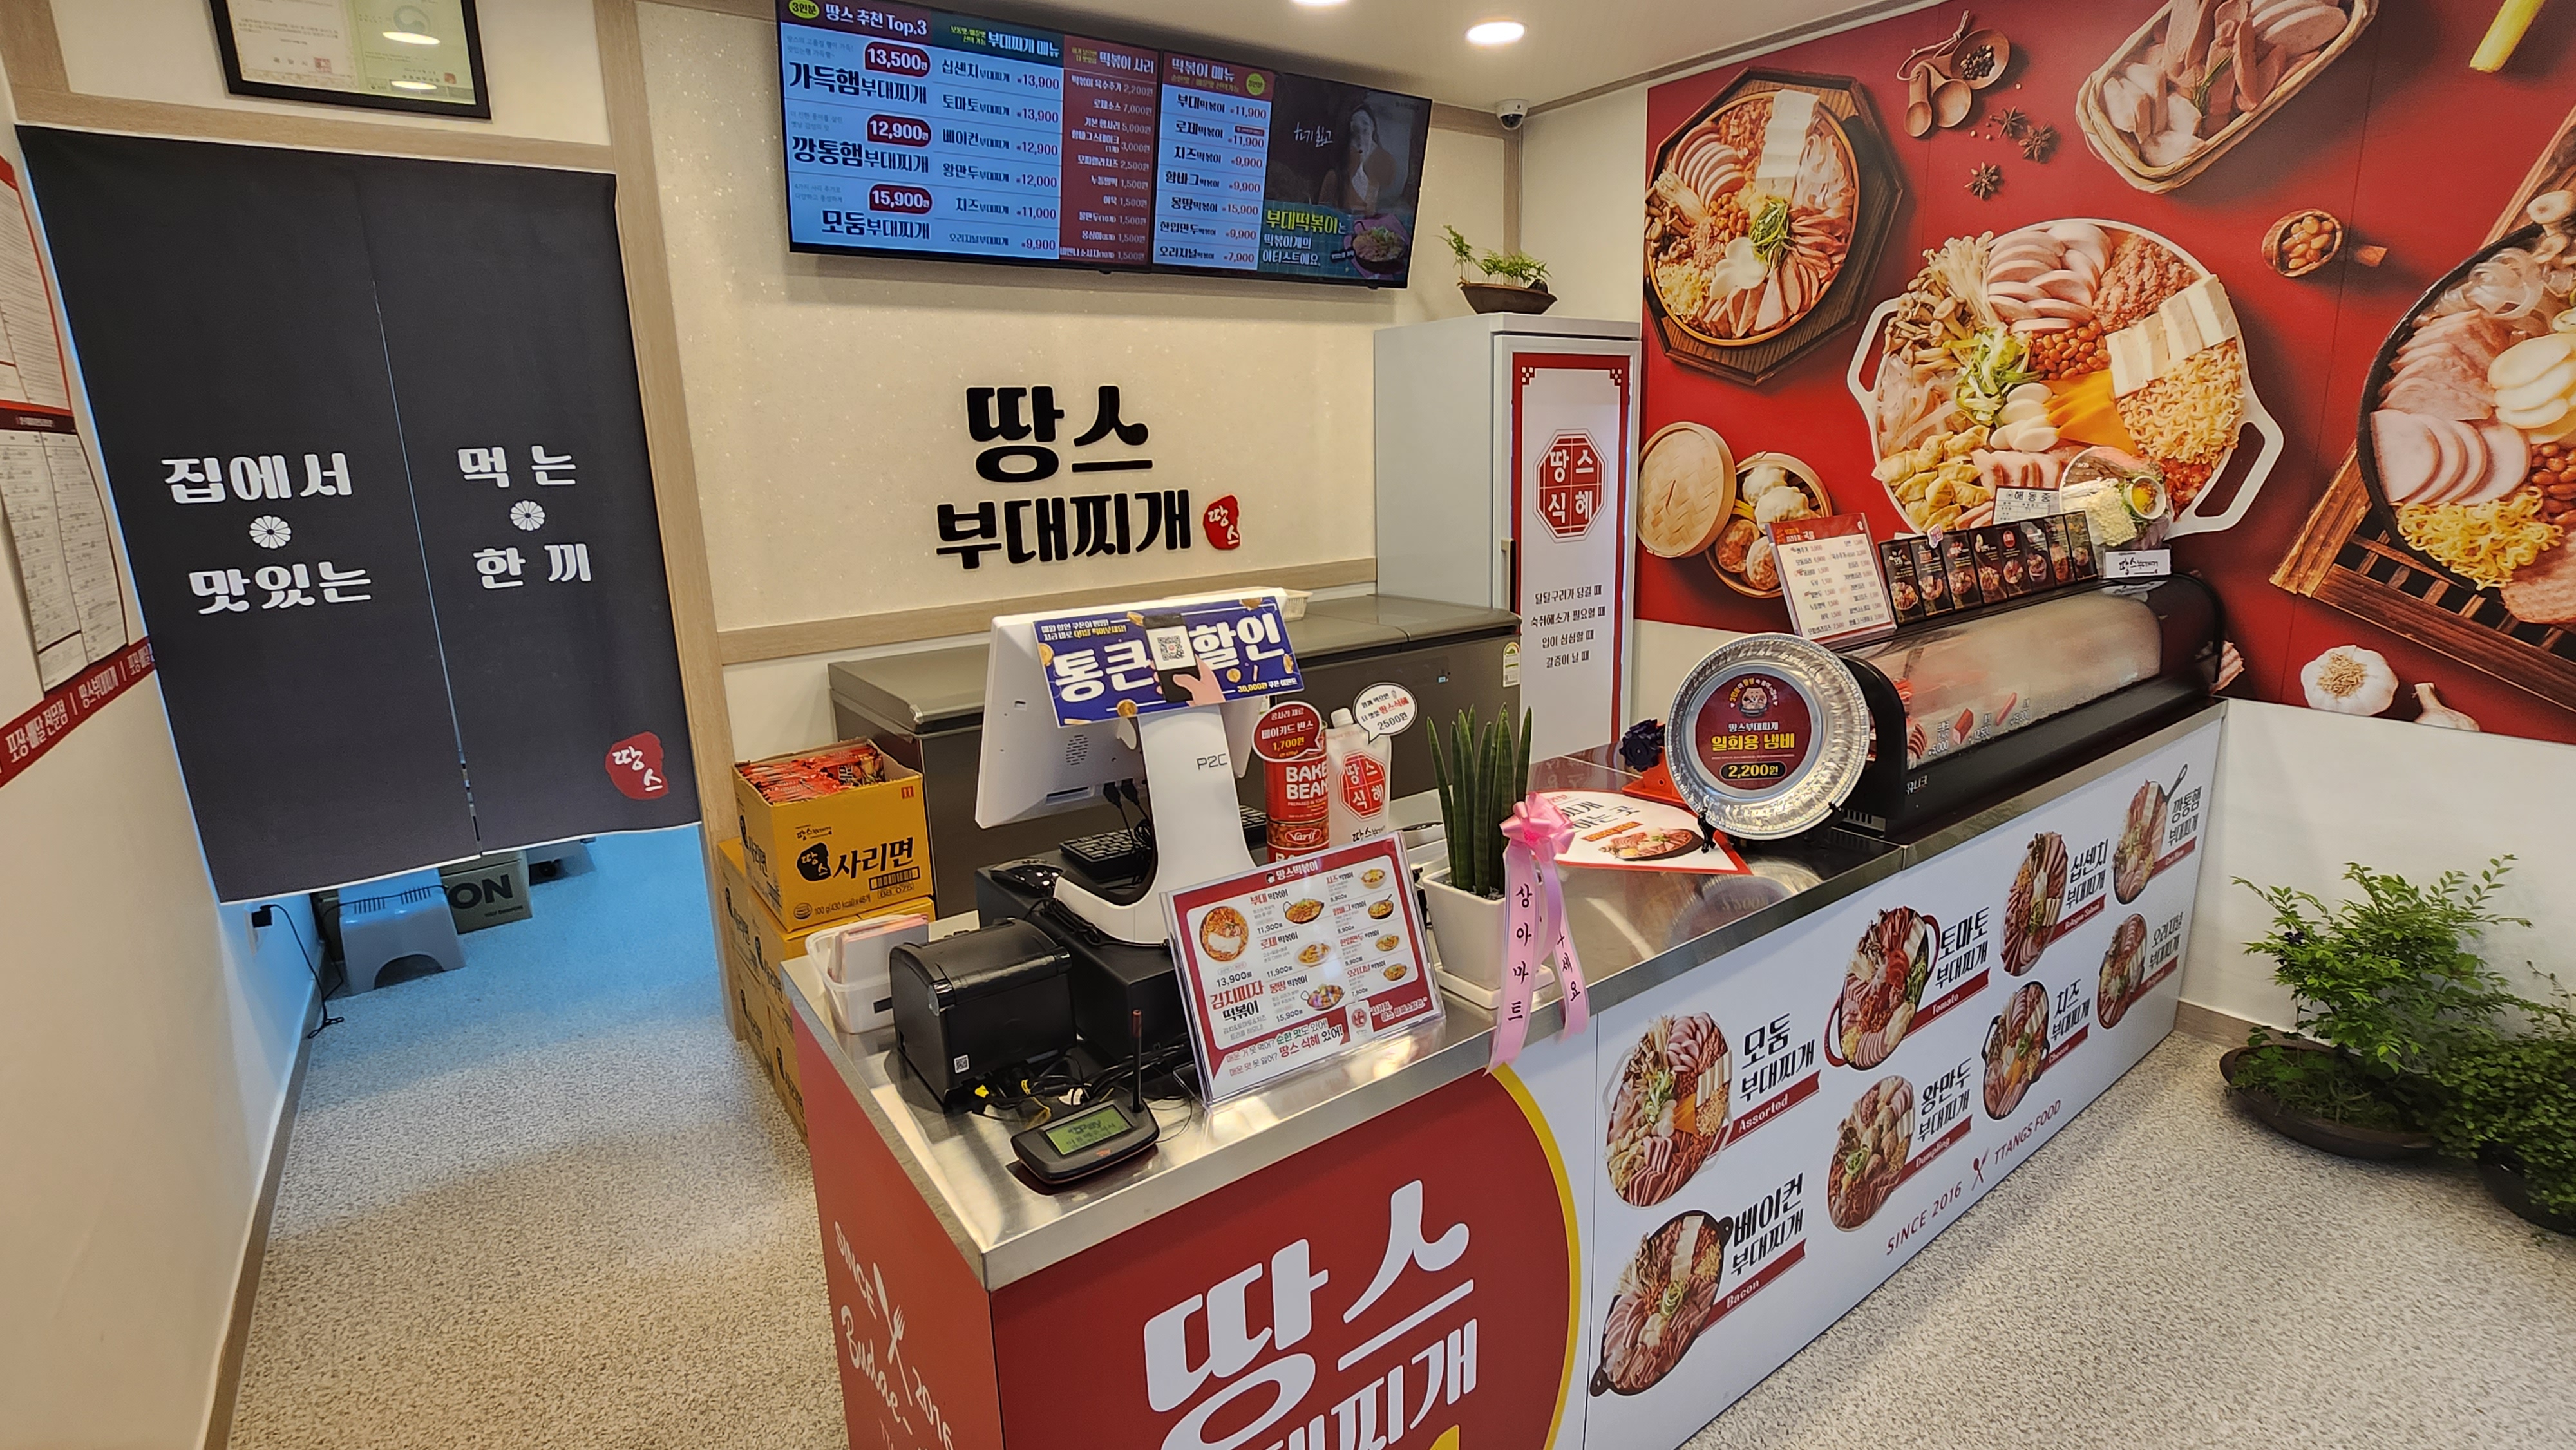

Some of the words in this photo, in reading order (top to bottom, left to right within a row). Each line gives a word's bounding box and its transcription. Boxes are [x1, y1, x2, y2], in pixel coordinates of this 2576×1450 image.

[791, 2, 817, 15] 3인분
[825, 3, 853, 23] 땅스
[857, 9, 883, 28] 추천
[886, 14, 927, 37] Top.3
[988, 31, 1034, 54] 부대찌개
[1037, 39, 1060, 59] 메뉴
[1099, 51, 1131, 70] 떡볶이
[1133, 57, 1155, 74] 사리
[1172, 57, 1208, 77] 떡볶이
[1211, 65, 1235, 82] 메뉴
[966, 385, 1153, 483] 땅스
[162, 453, 353, 504] 집에서
[936, 489, 1191, 569] 부대찌개
[1208, 505, 1239, 545] 땅스
[189, 561, 372, 615] 맛있는
[1535, 588, 1575, 605] 달달구리가
[1594, 585, 1602, 596] 때
[1057, 623, 1071, 632] 할인
[1072, 621, 1092, 630] 쿠폰이
[1531, 611, 1570, 628] 숙취해소가
[1573, 607, 1595, 621] 필요할
[1598, 606, 1605, 617] 때
[1044, 632, 1058, 641] 지금
[1058, 631, 1074, 639] 바로
[1542, 636, 1558, 649] 입이
[1560, 630, 1584, 646] 심심할
[1586, 629, 1594, 641] 때
[1053, 639, 1155, 703] 통큰
[1189, 613, 1285, 671] 할인
[1546, 654, 1569, 668] 갈증이
[1581, 650, 1589, 661] 때
[1378, 711, 1408, 730] 2500원
[1272, 736, 1305, 752] 1,700원
[1712, 734, 1759, 751] 일회용
[1764, 733, 1795, 749] 냄비
[612, 746, 663, 793] 땅스
[1197, 753, 1227, 770] P2C
[1728, 764, 1779, 778] 2,200원
[801, 851, 828, 876] 땅스
[833, 836, 913, 879] 사리면
[1276, 860, 1318, 880] 땅스떡볶이
[2070, 838, 2108, 883] 십센치
[449, 874, 513, 909] ON
[1250, 893, 1267, 906] 부대
[1268, 889, 1289, 901] 떡볶이
[2065, 869, 2106, 909] 부대찌개
[1260, 936, 1278, 950] 로제
[1278, 931, 1298, 943] 떡볶이
[1938, 906, 1989, 961] 토마토
[1287, 975, 1308, 986] 떡볶이
[1935, 939, 1989, 989] 부대찌개
[1210, 980, 1264, 1010] 김치피자
[1222, 1000, 1260, 1021] 떡볶이
[1932, 993, 1959, 1015] Tomato
[2054, 978, 2081, 1019] 치즈
[1276, 1033, 1292, 1045] 순한
[1293, 1027, 1309, 1039] 맛도
[1311, 1019, 1328, 1032] 있어!
[2051, 998, 2090, 1041] 부대찌개
[1279, 1044, 1300, 1058] 땅스
[1301, 1034, 1320, 1049] 식혜
[1321, 1026, 1343, 1042] 있어!
[1741, 1013, 1790, 1070] 모둠
[1739, 1039, 1815, 1102] 부대찌개
[1920, 1057, 1972, 1116] 왕만두
[1739, 1093, 1788, 1133] Assorted
[1917, 1089, 1970, 1142] 부대찌개
[1886, 1209, 1927, 1256] SINCE
[1932, 1180, 1962, 1218] 2016
[1994, 1122, 2032, 1165] TTANGS
[2034, 1099, 2061, 1131] FOOD
[1734, 1172, 1803, 1248] 베이컨
[1730, 1207, 1804, 1276] 부대찌개
[835, 1221, 877, 1321] SINCE
[1726, 1279, 1759, 1309] Bacon
[1144, 1180, 1474, 1450] 땅스
